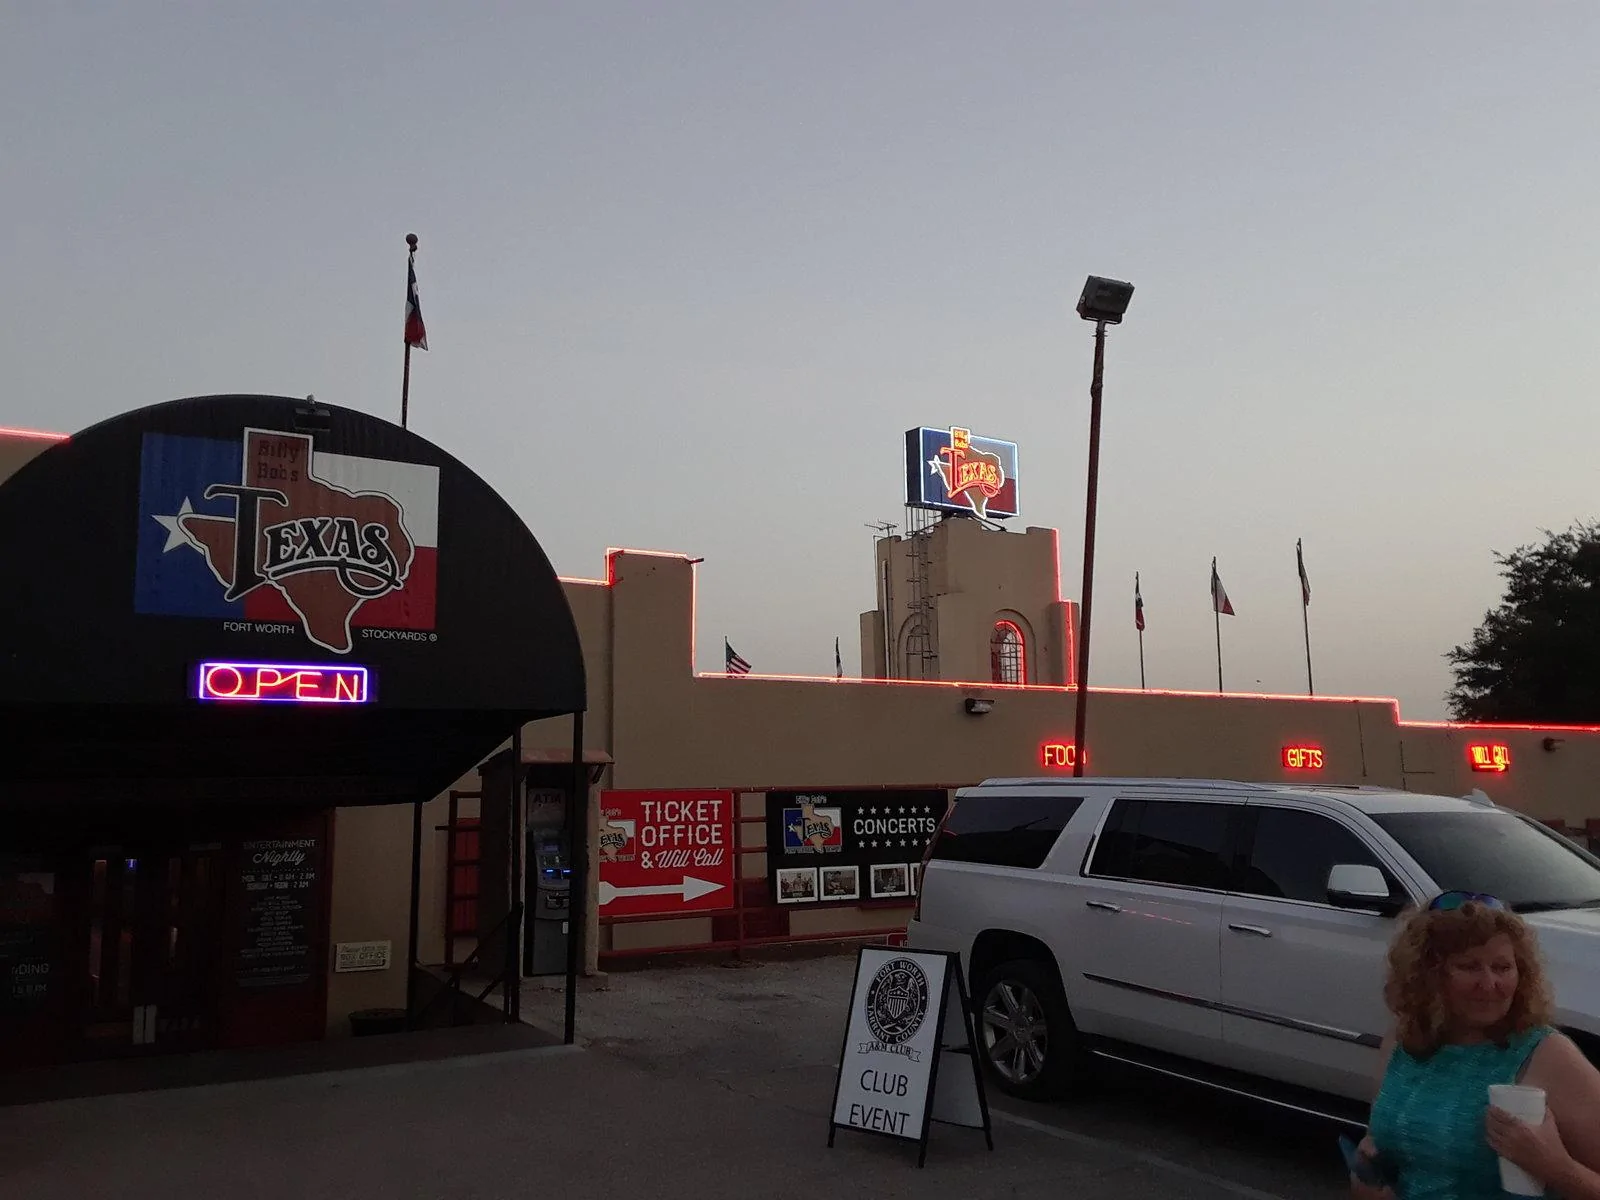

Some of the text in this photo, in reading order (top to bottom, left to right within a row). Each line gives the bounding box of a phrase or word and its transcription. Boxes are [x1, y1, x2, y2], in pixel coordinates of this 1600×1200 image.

[204, 485, 404, 602] TEXAS
[223, 621, 295, 634] FORT WORTH
[362, 629, 427, 641] STOCKYARDS
[206, 667, 359, 701] OPEN
[1287, 748, 1323, 768] GIFTS
[640, 799, 723, 823] TICKET
[641, 823, 723, 847] OFFICE
[853, 817, 936, 835] CONCERTS
[243, 839, 316, 849] ENTERTAINMENT
[641, 847, 724, 869] & Will Call
[900, 960, 926, 986] WORTH
[860, 1069, 909, 1097] CLUB
[850, 1103, 911, 1135] EVENT
